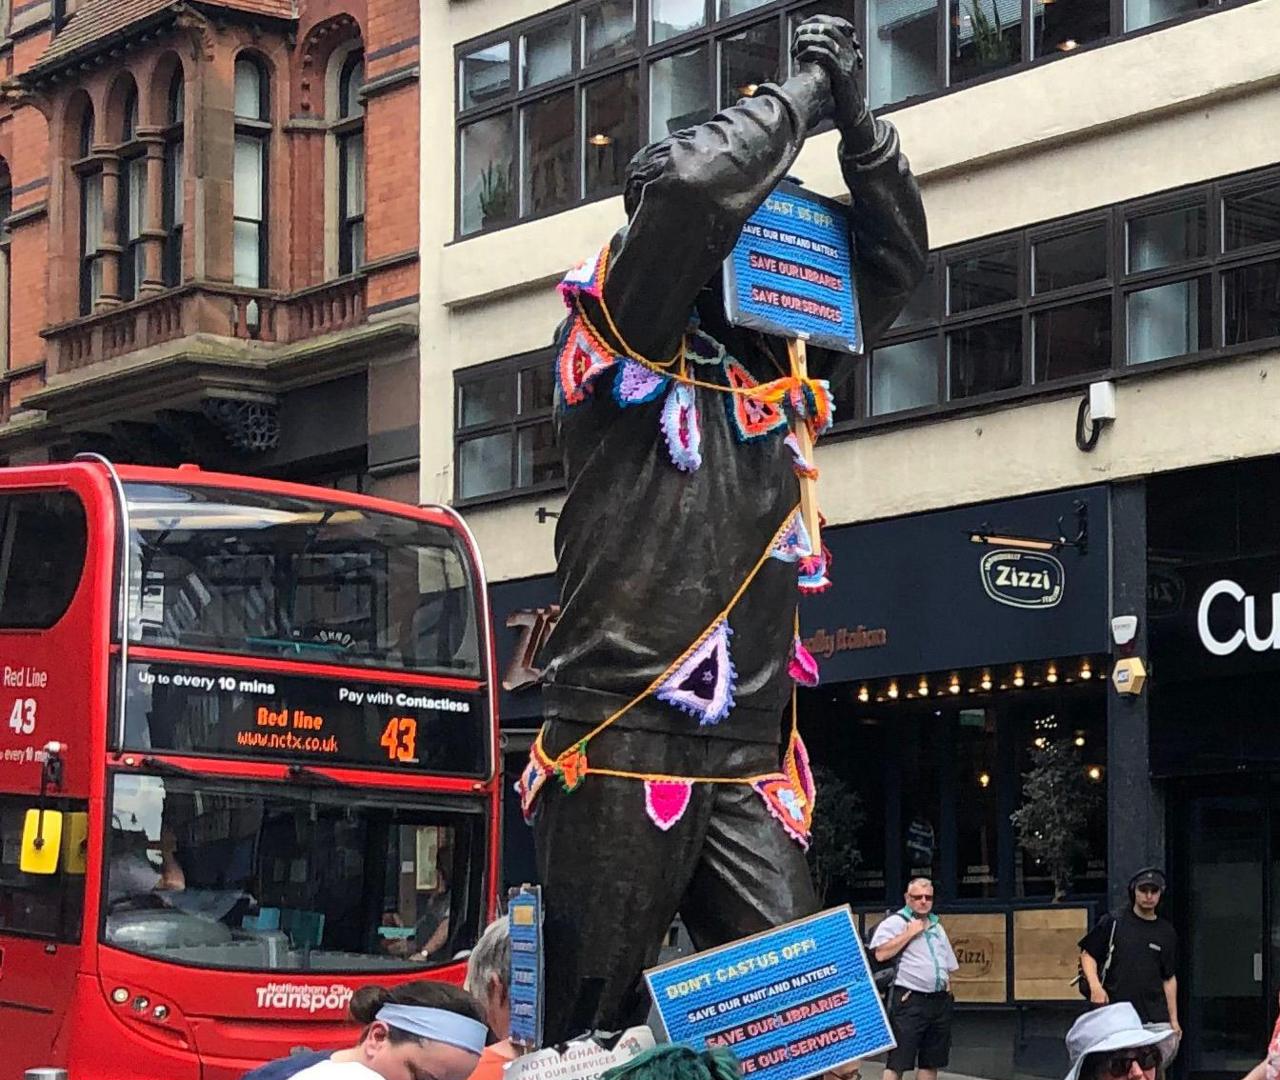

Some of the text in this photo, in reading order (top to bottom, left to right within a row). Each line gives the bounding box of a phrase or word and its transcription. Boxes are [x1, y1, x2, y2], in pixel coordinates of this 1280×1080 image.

[742, 224, 761, 238] SAVE
[763, 228, 778, 240] OUR
[797, 237, 810, 250] AND
[812, 240, 839, 260] NATTERS
[751, 255, 843, 291] SAVE OUR LIBRARIES
[752, 287, 842, 322] SAVE OUR SERVICES
[995, 565, 1051, 590] Zizzi
[3, 666, 48, 689] Red Line
[138, 671, 275, 695] Up to every 10 mins
[339, 688, 470, 713] Pay with Contactless
[9, 698, 37, 735] 43
[293, 709, 323, 730] line
[237, 731, 338, 752] www.nctx.co.uk
[380, 716, 417, 761] 43
[267, 982, 329, 995] Nottingham
[666, 973, 711, 1000] DON'T
[715, 958, 751, 983] CAST
[752, 951, 779, 972] US
[256, 987, 353, 1013] Transport
[687, 963, 839, 1023] SAVE OUR KNIT AND NATTERS
[707, 990, 850, 1048] SAVE OUR LIBRARIES
[758, 1047, 788, 1068] OUR
[789, 1023, 857, 1058] SERVICES
[545, 1066, 568, 1080] OUR
[570, 1055, 617, 1073] SERVICES
